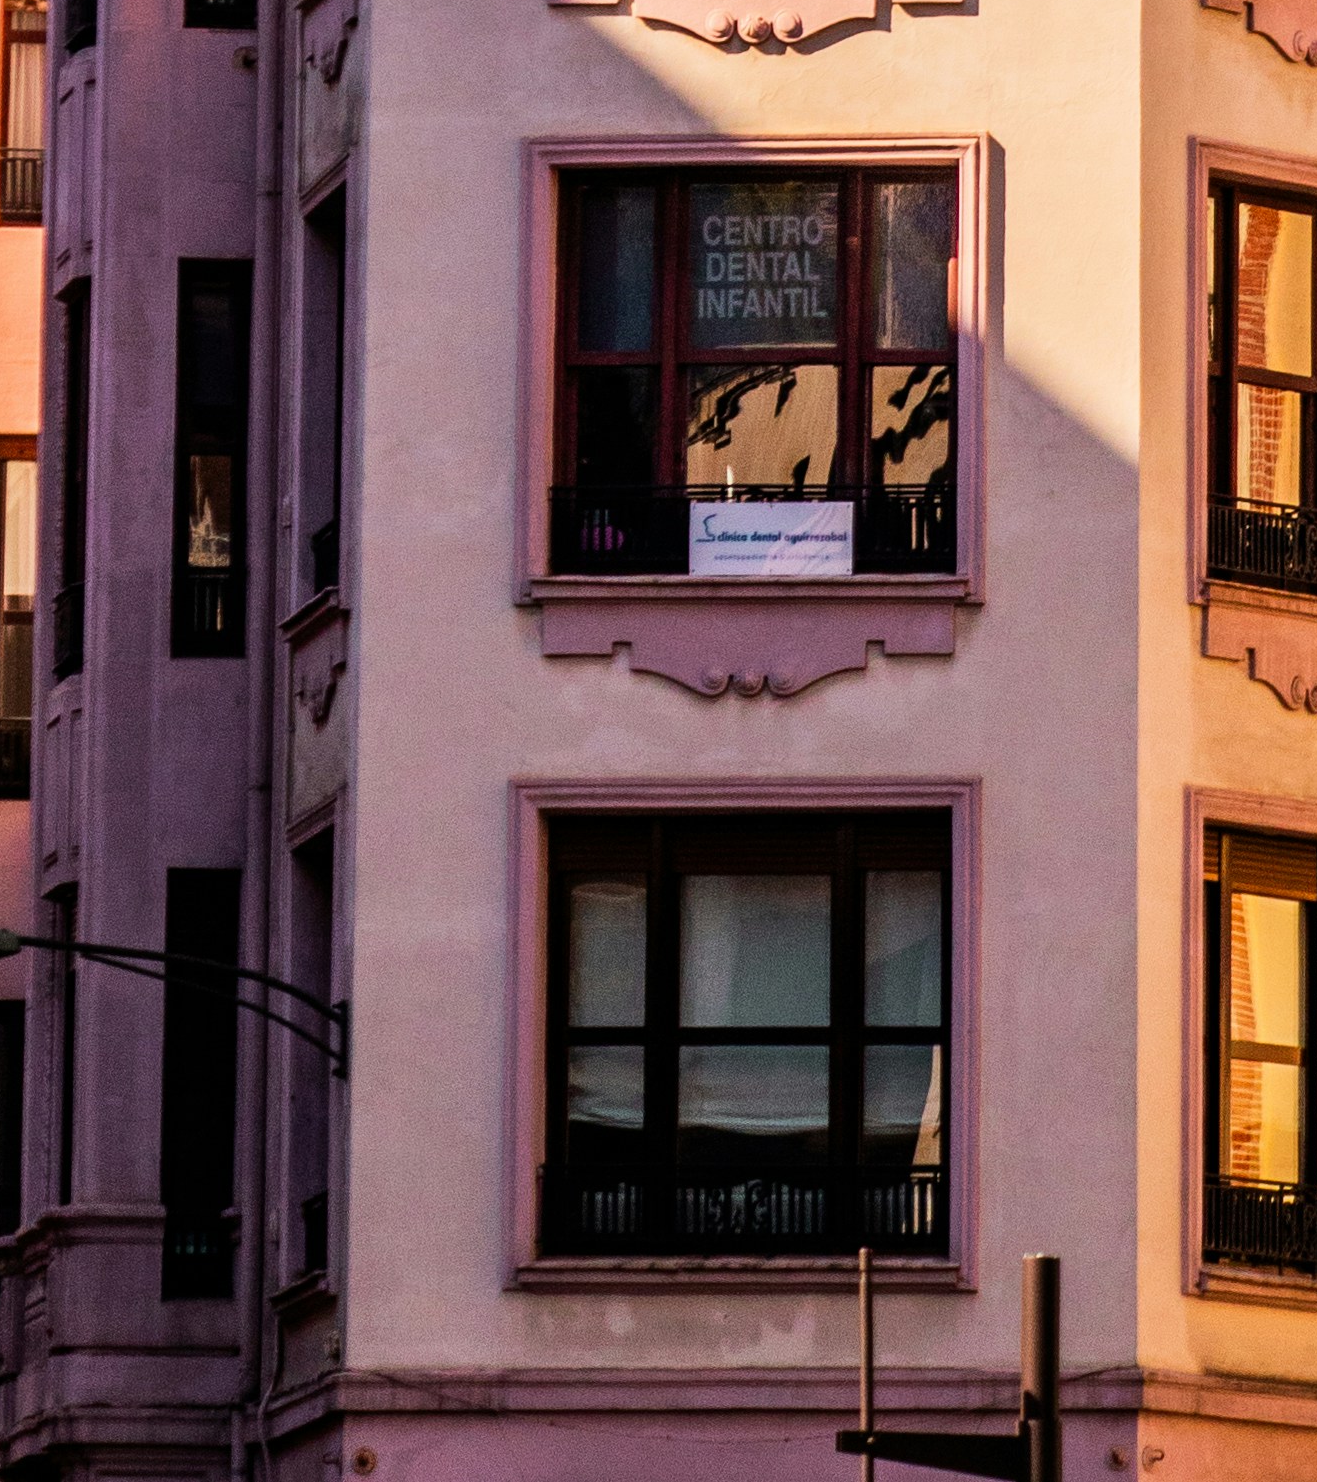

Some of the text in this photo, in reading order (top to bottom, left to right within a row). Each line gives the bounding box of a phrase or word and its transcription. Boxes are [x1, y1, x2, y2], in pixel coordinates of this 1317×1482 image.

[703, 215, 823, 245] CENTRO
[706, 251, 820, 281] DENTAL
[698, 288, 829, 318] INFANTIL
[750, 531, 781, 542] dental
